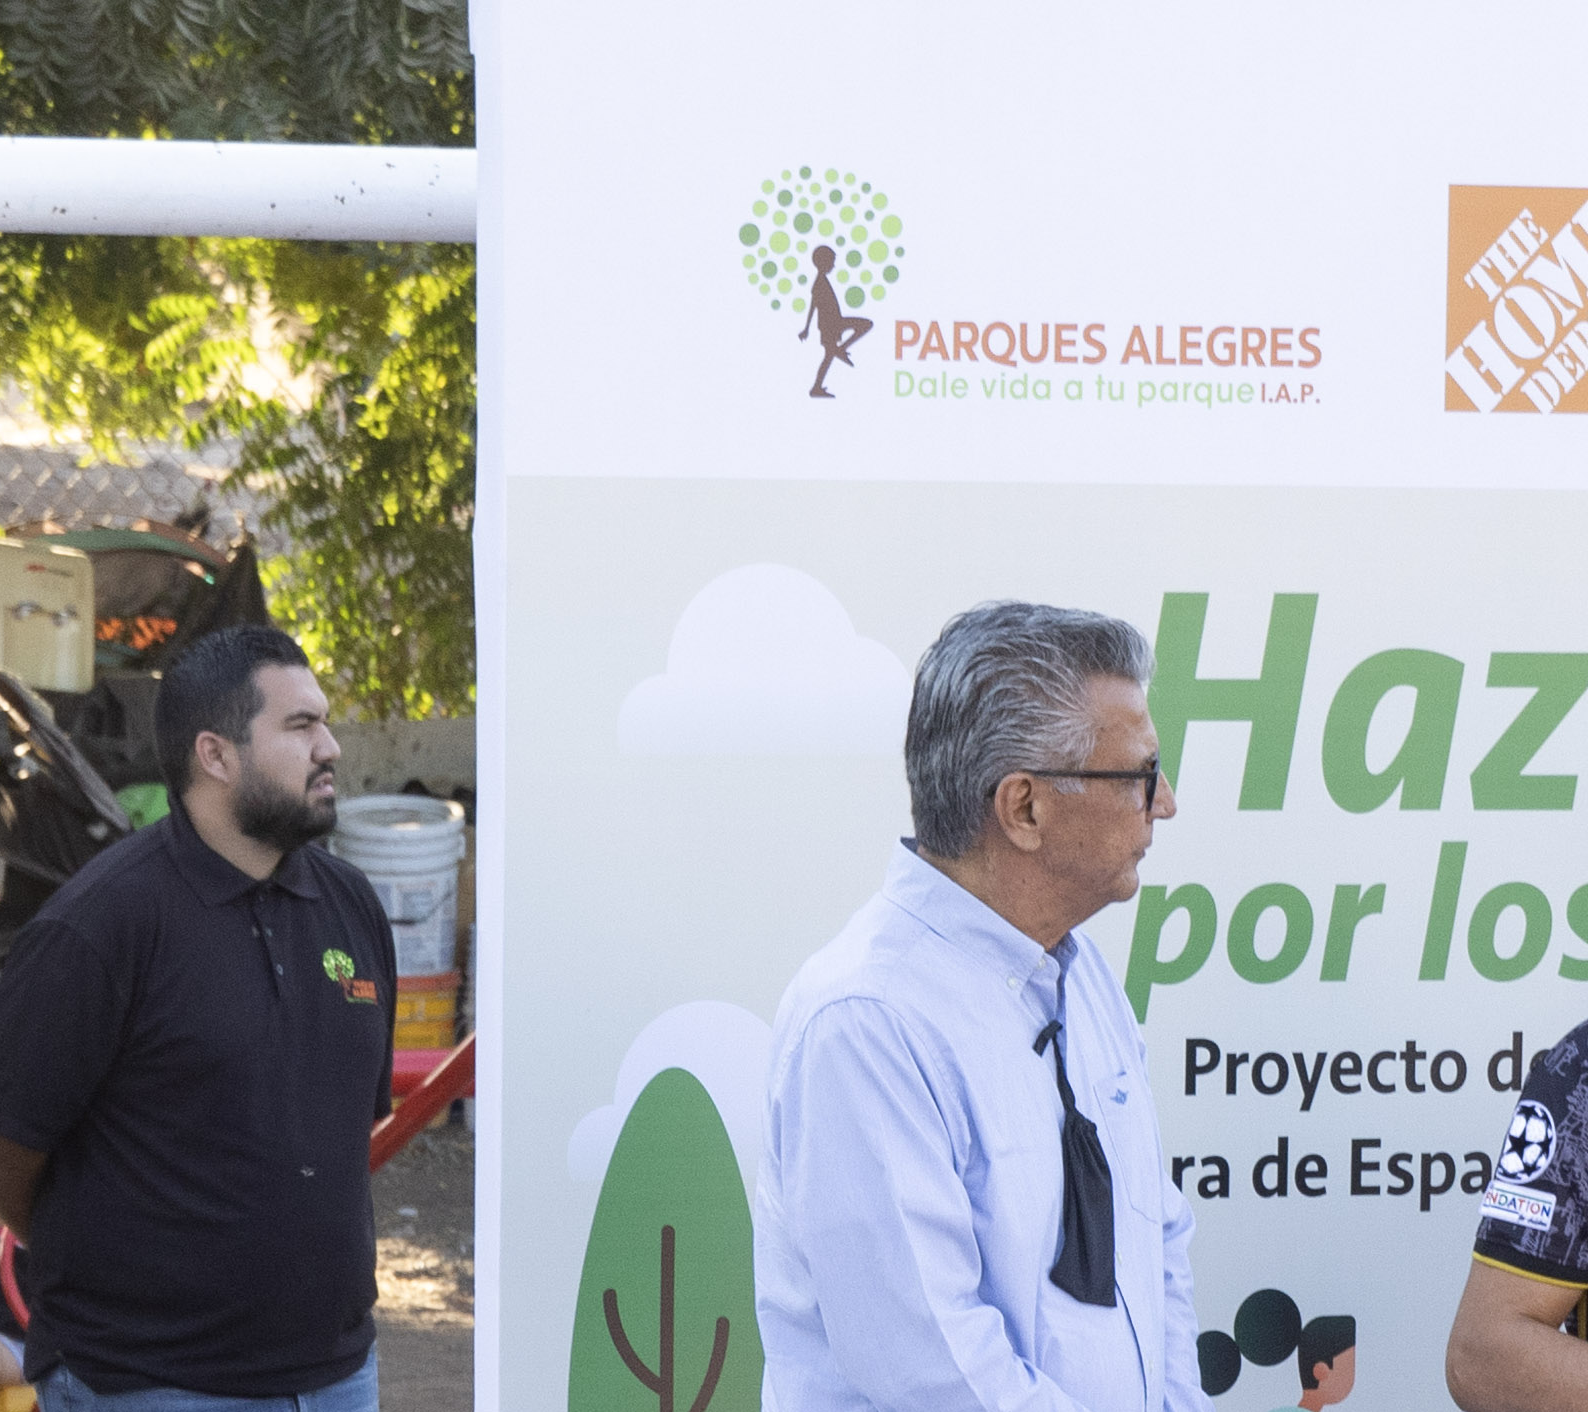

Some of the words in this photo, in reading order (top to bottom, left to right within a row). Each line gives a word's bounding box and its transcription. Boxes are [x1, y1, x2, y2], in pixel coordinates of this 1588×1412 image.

[1463, 206, 1549, 303] THE
[894, 320, 1108, 368] PARQUES
[1120, 325, 1323, 368] ALEGRES
[894, 370, 970, 400] Dale
[981, 373, 1052, 401] vida
[1063, 379, 1083, 401] a
[1095, 374, 1125, 402] tu
[1136, 379, 1256, 410] parque
[1123, 881, 1387, 1024] por
[1184, 1037, 1468, 1112] Proyecto
[1252, 1136, 1329, 1198] de
